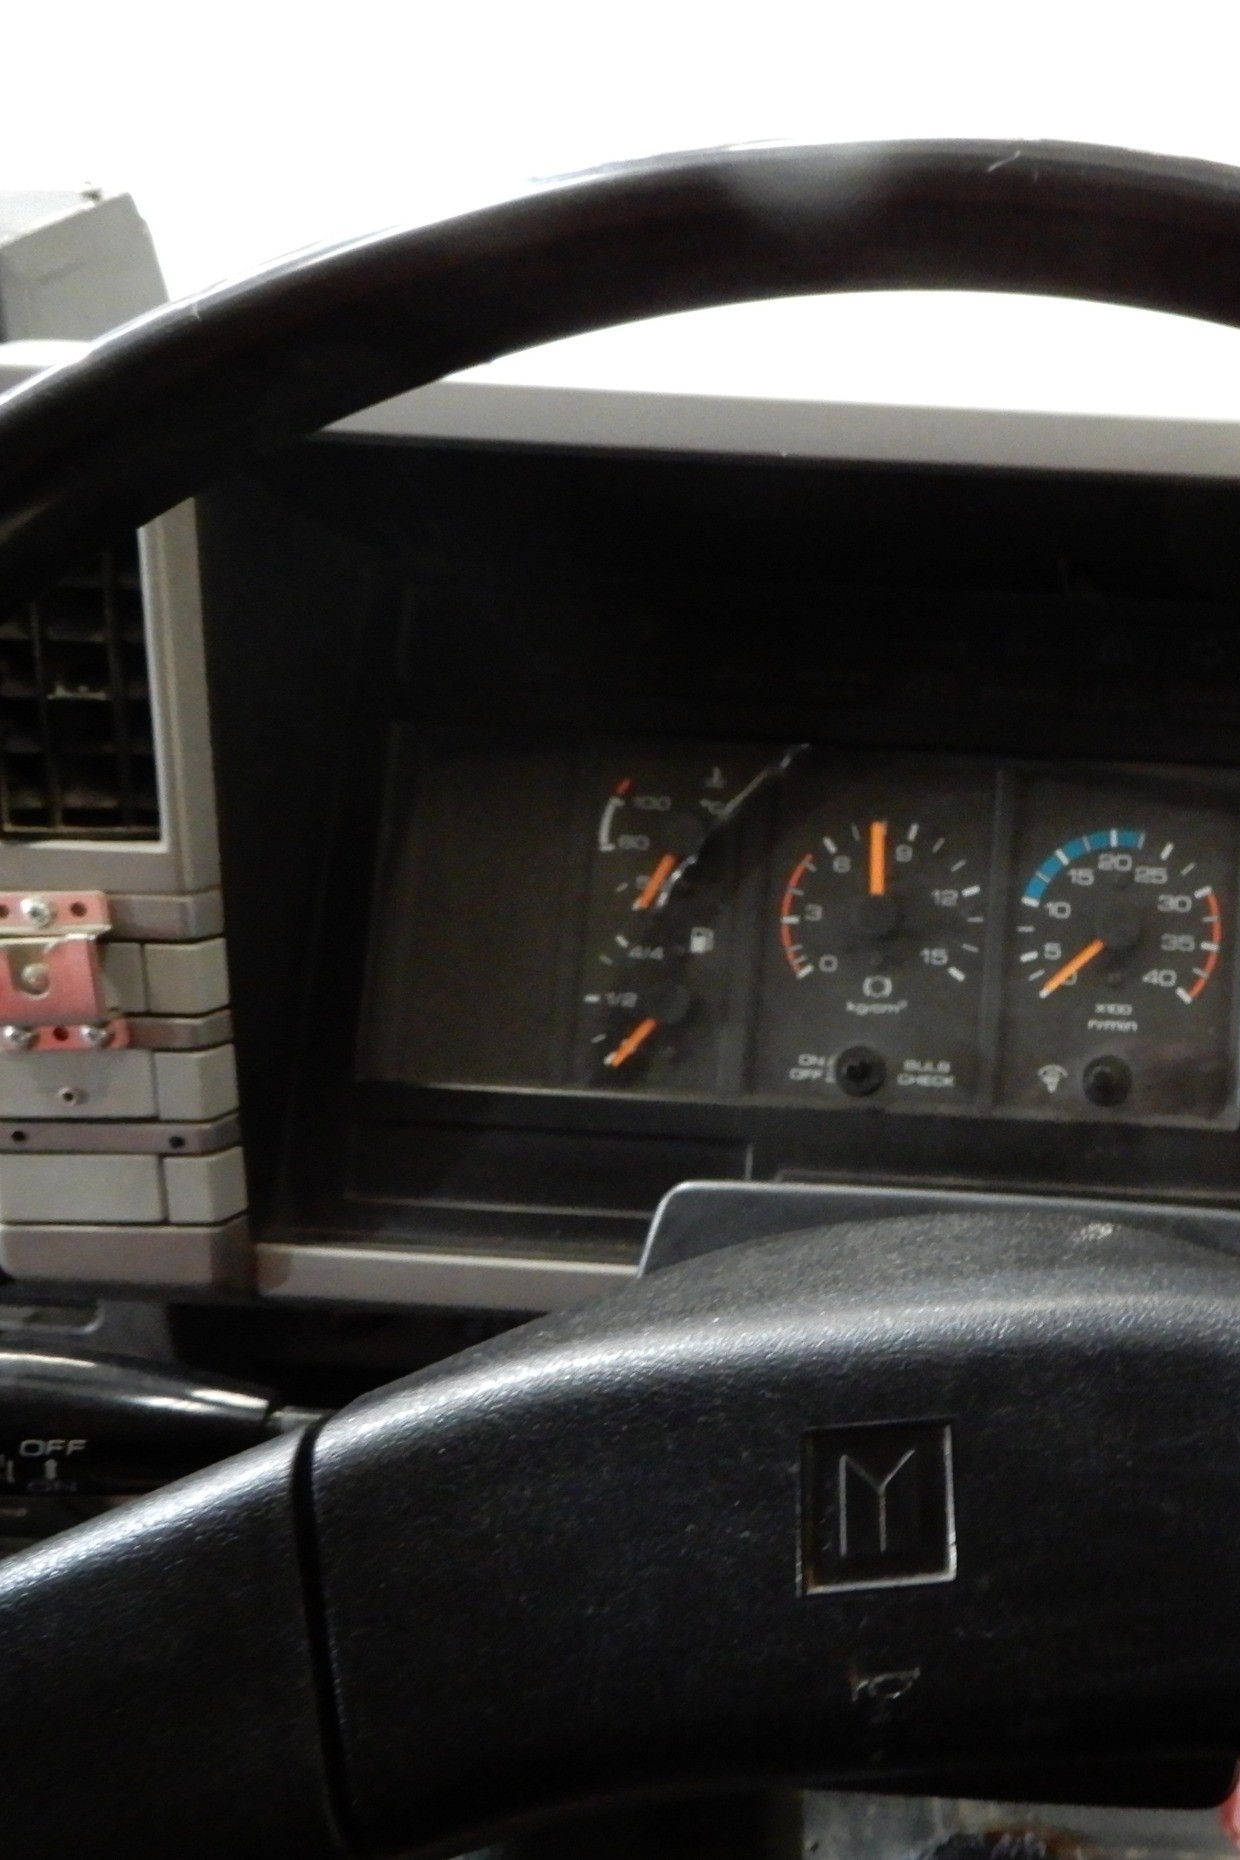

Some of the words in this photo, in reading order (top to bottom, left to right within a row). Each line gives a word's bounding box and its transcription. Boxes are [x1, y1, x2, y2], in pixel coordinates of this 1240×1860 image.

[833, 855, 851, 873] 6
[1098, 854, 1132, 872] 20
[1069, 868, 1095, 886] 15
[1134, 866, 1168, 885] 25
[932, 889, 958, 907] 12
[1158, 894, 1192, 913] 30
[805, 904, 822, 922] 3
[1046, 902, 1072, 919] 10
[1044, 943, 1062, 960] 5
[1161, 933, 1196, 952] 35
[921, 948, 949, 966] 15
[1142, 969, 1178, 987] 40
[19, 1438, 89, 1458] OFF
